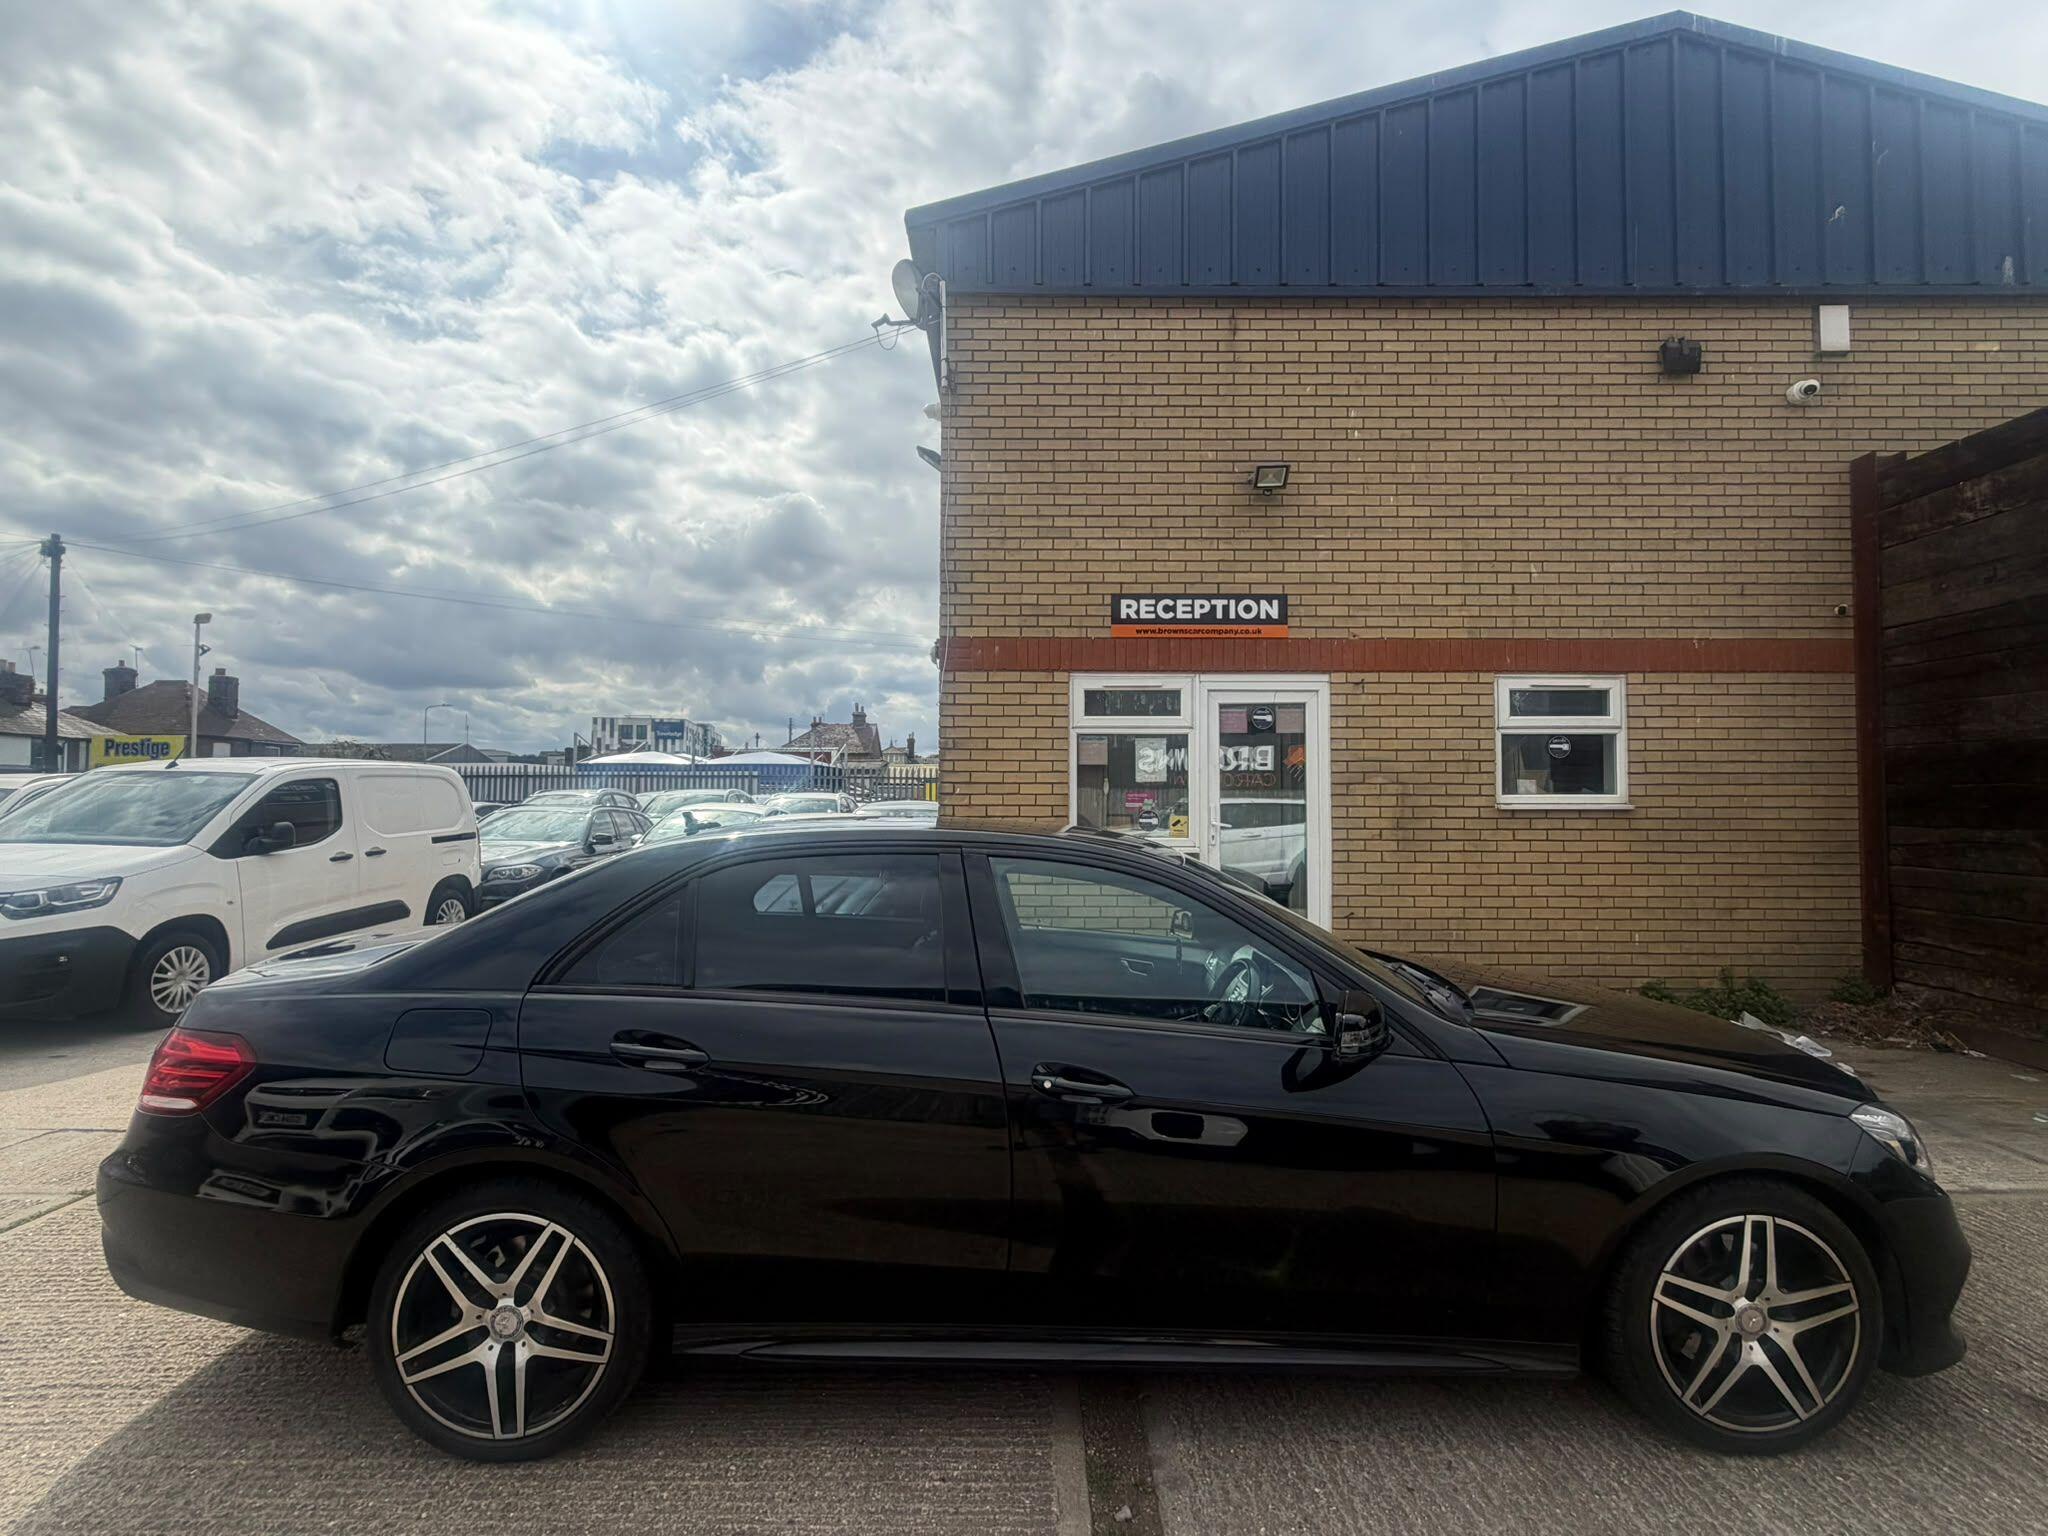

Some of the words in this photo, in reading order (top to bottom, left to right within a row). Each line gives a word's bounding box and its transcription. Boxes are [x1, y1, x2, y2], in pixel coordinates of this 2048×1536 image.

[1120, 599, 1279, 619] RECEPTION
[1135, 628, 1262, 636] www.brownscarcompany.co.uk
[104, 738, 170, 759] Prestige
